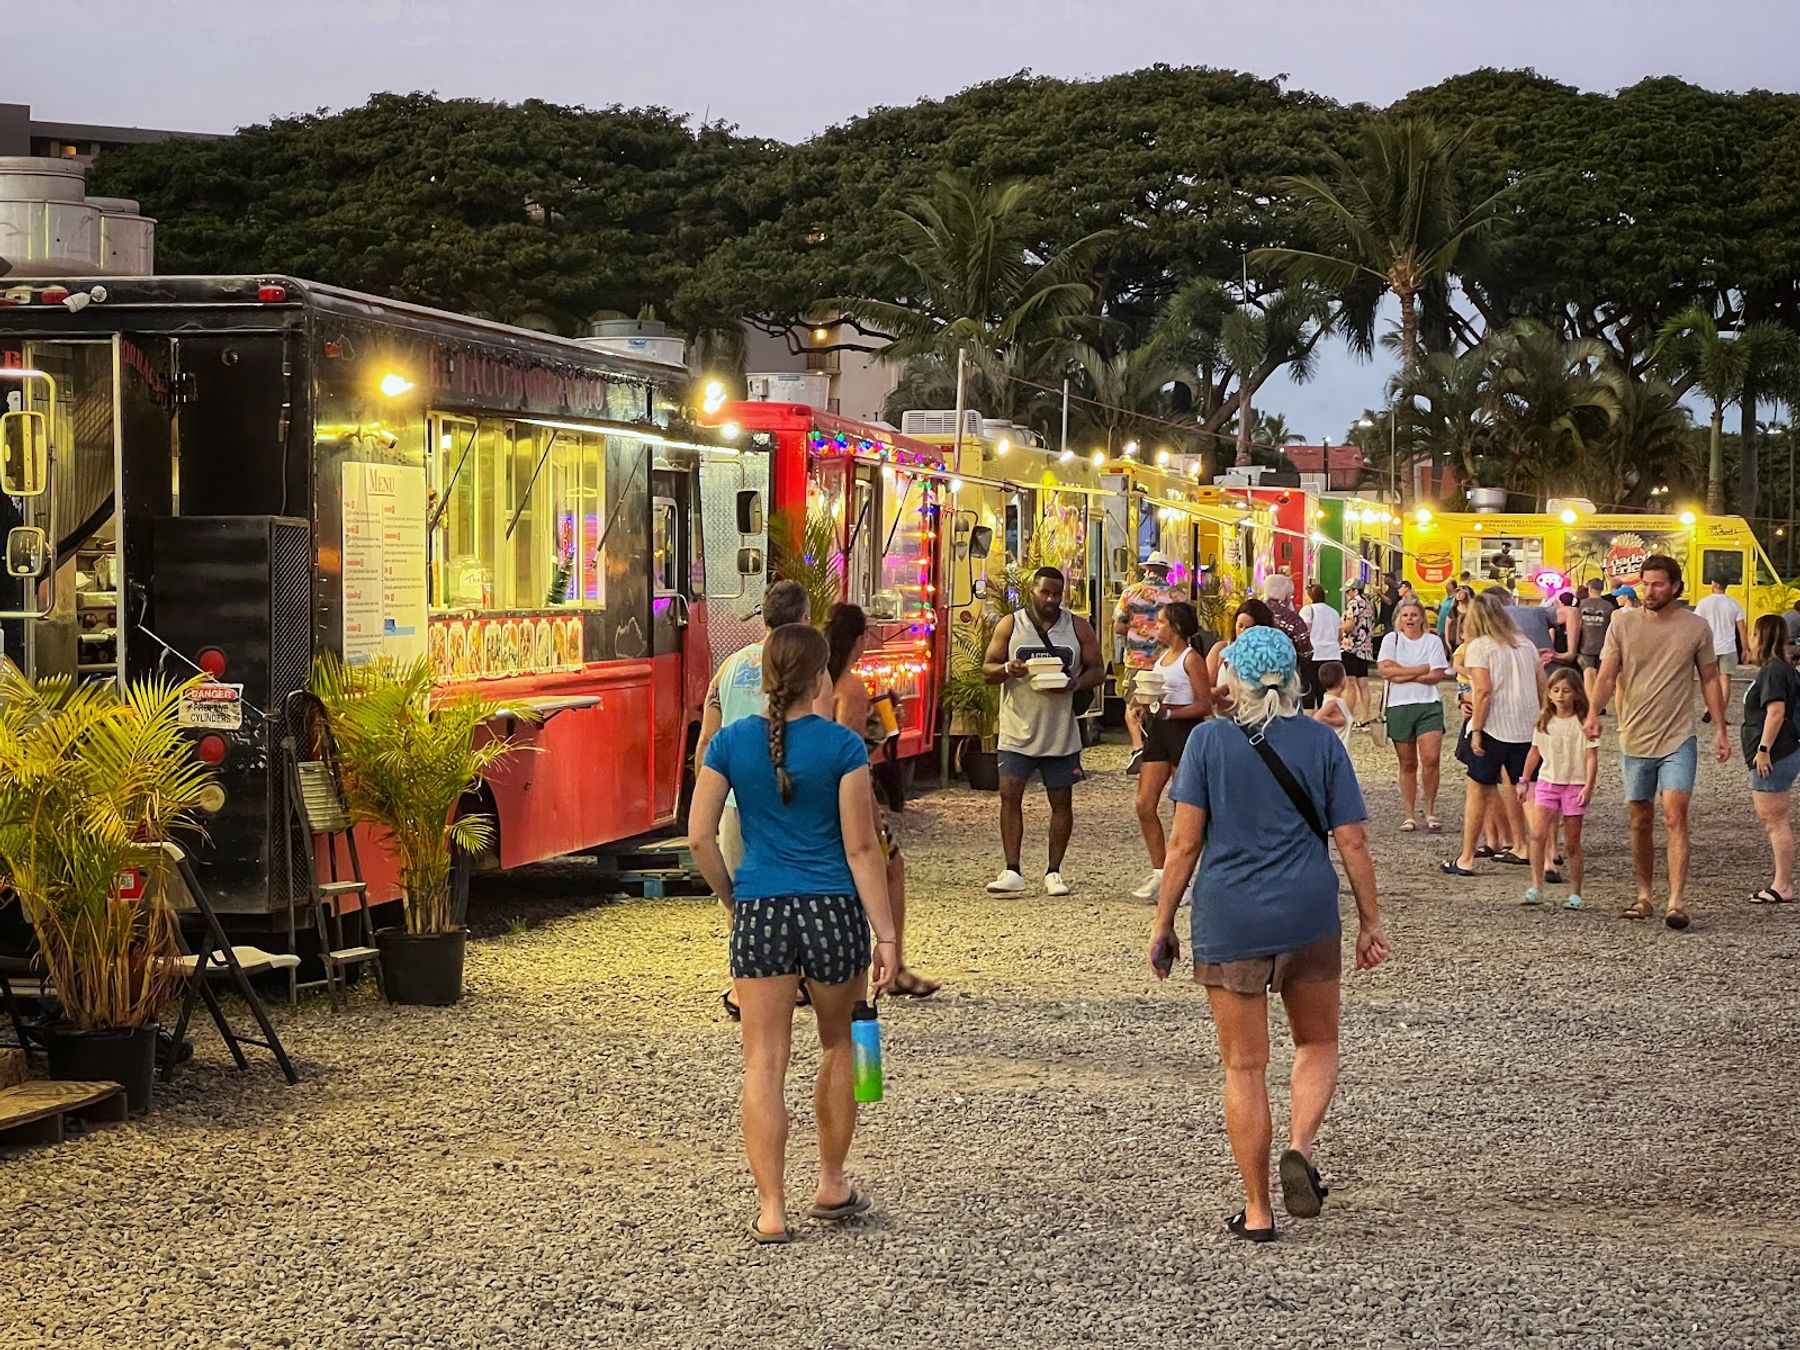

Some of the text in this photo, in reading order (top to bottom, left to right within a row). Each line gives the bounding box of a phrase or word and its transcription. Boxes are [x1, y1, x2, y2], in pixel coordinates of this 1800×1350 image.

[457, 350, 508, 398] TACO
[1602, 550, 1652, 569] Loaded
[191, 689, 231, 699] DANGER
[190, 713, 232, 723] CYLINDERS
